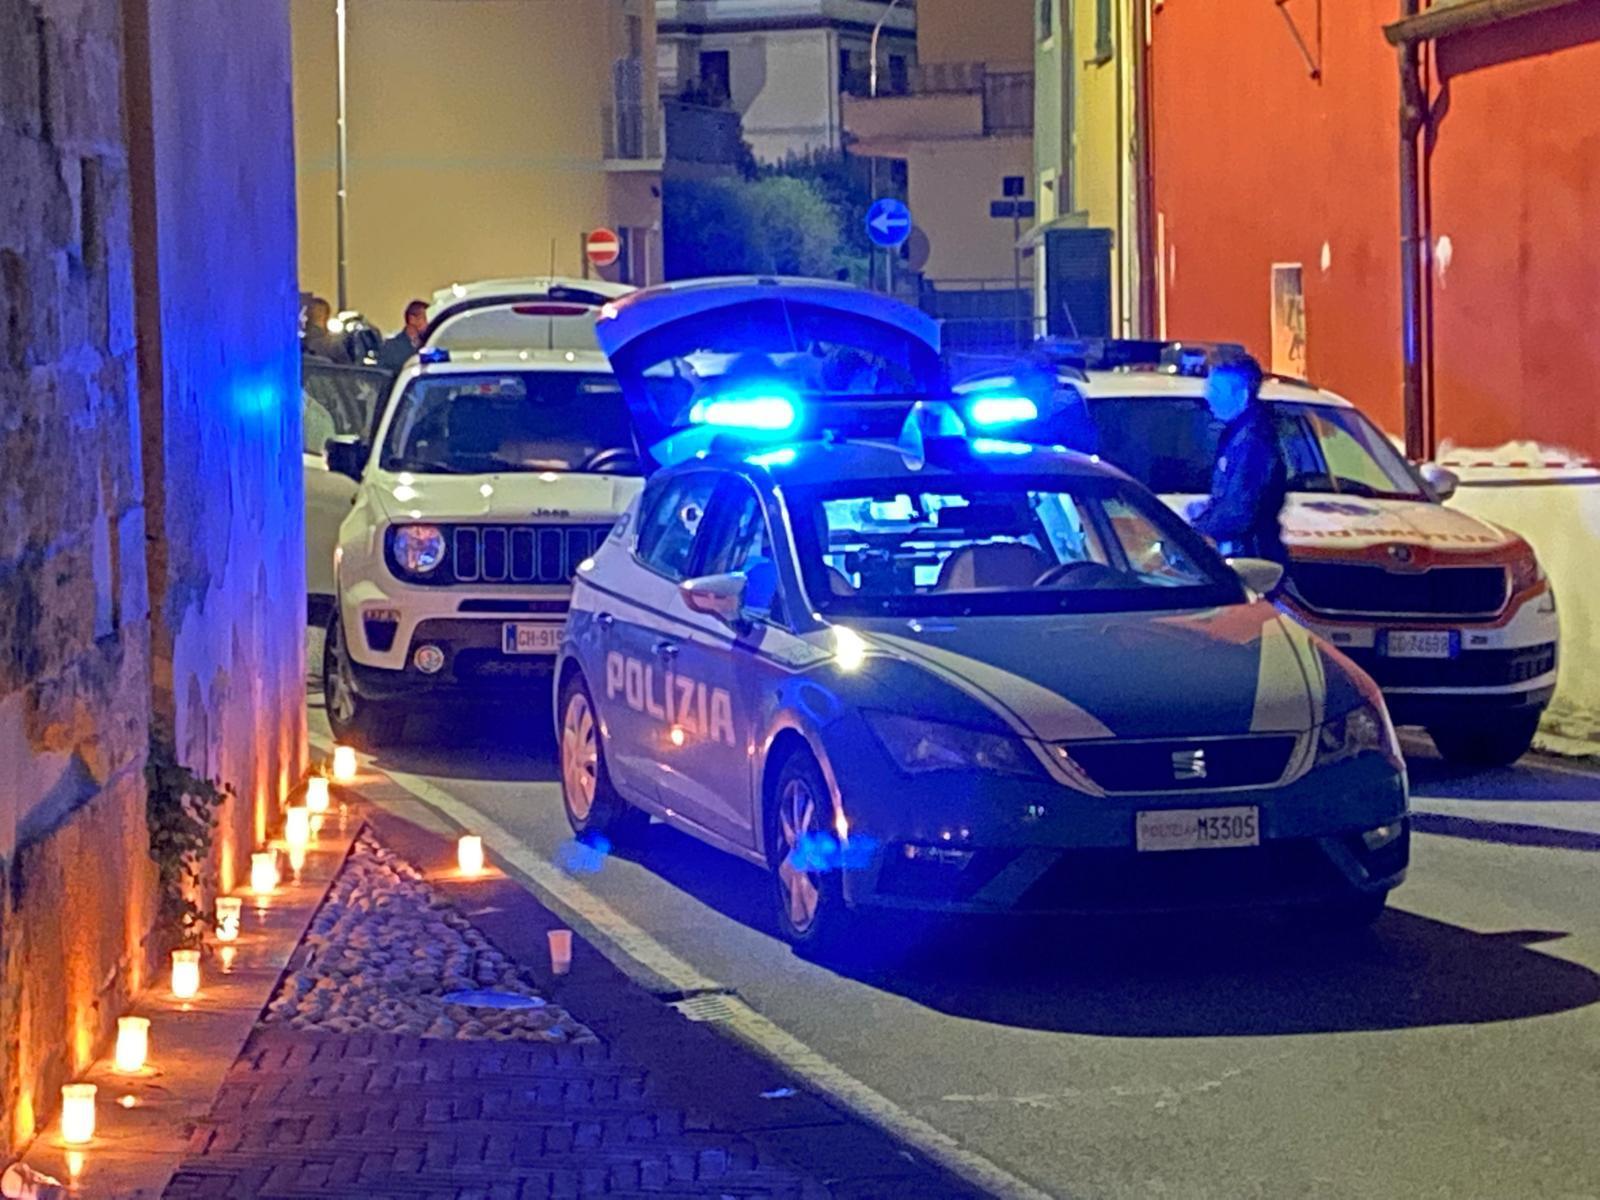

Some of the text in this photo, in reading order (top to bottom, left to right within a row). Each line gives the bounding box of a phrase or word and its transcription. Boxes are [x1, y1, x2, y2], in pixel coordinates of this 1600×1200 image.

[531, 507, 570, 520] Jeep
[606, 651, 737, 747] POLIZIA
[1197, 814, 1256, 841] M3305
